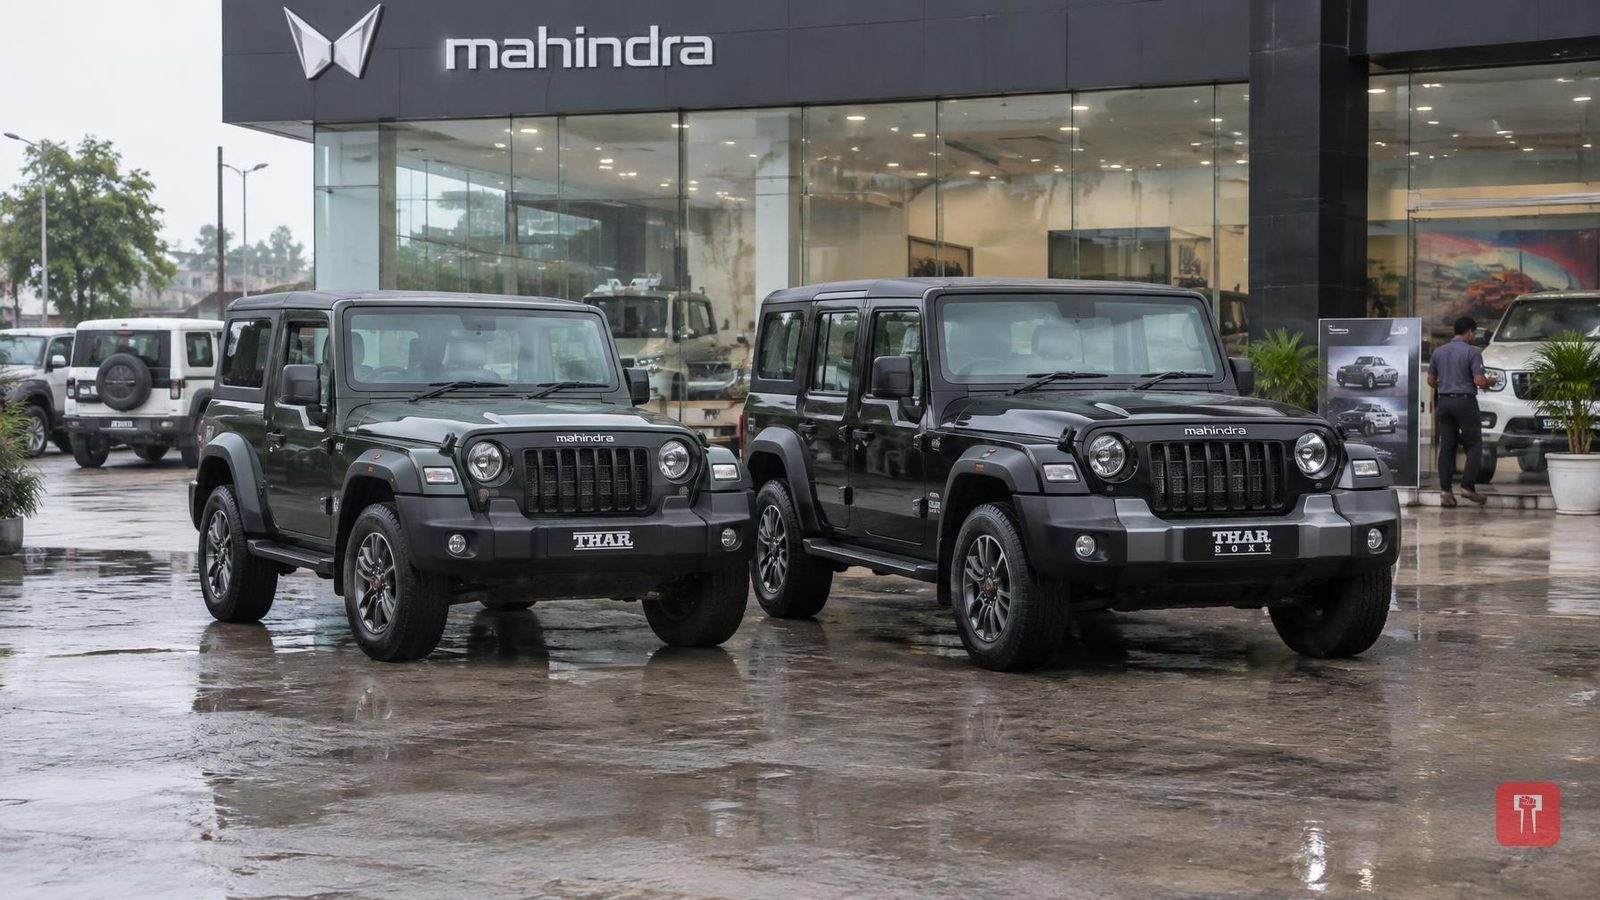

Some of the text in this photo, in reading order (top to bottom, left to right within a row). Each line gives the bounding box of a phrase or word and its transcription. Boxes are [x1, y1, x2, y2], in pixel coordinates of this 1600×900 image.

[446, 25, 713, 70] mahindra
[1184, 426, 1247, 435] mahindra
[556, 433, 614, 443] mahindra
[573, 532, 634, 548] THAR
[1212, 530, 1272, 543] THAR
